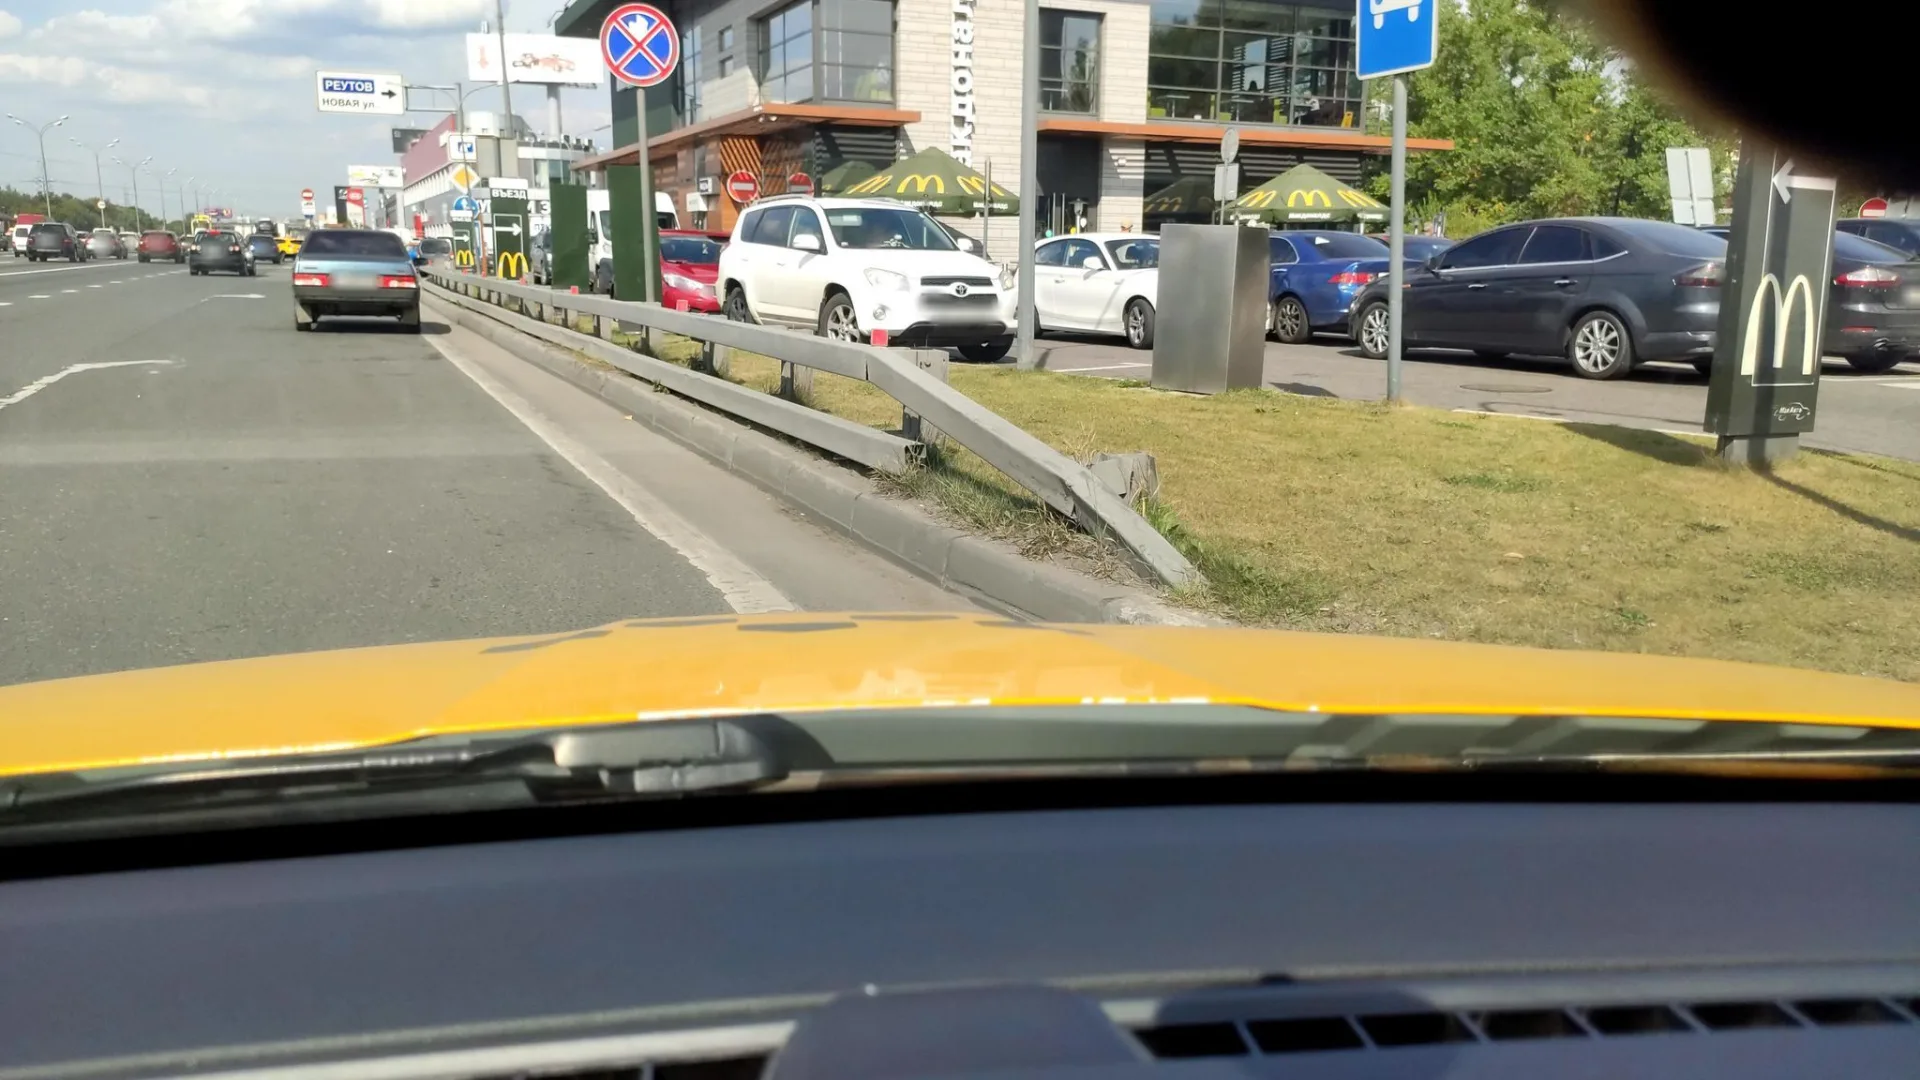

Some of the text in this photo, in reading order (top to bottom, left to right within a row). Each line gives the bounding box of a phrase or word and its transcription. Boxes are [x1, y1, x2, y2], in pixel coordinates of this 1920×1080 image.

[324, 79, 373, 93] РЕУТОВ
[322, 97, 360, 108] НОВАЯ
[491, 188, 527, 200] ВЪЕЗД
